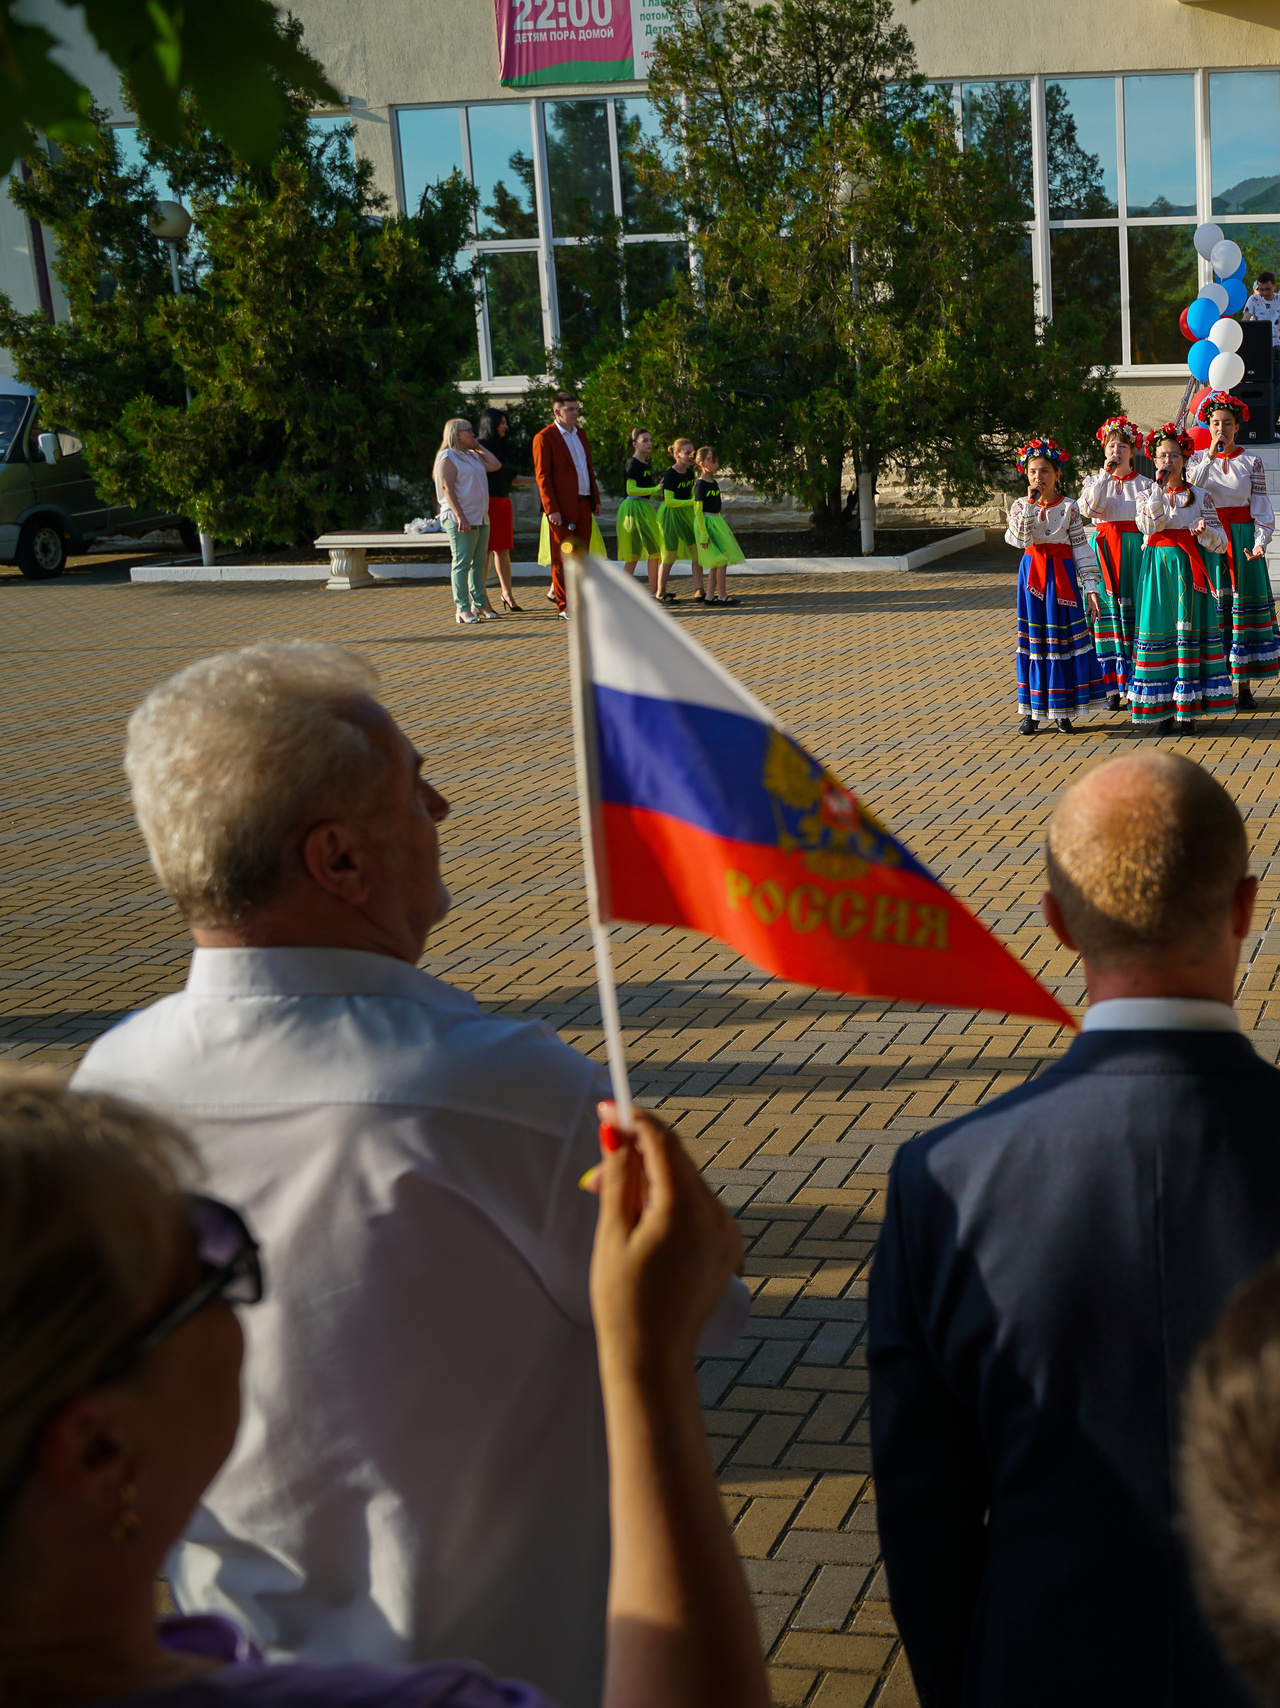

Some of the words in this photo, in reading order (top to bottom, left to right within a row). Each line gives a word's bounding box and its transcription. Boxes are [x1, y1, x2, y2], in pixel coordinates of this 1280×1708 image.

[512, 0, 613, 30] 22:00
[639, 12, 674, 22] потому
[514, 31, 547, 44] ДЕТЯМ
[550, 30, 576, 41] ПОРА
[578, 26, 614, 41] ДОМОЙ
[724, 868, 951, 951] РОССИЯ
